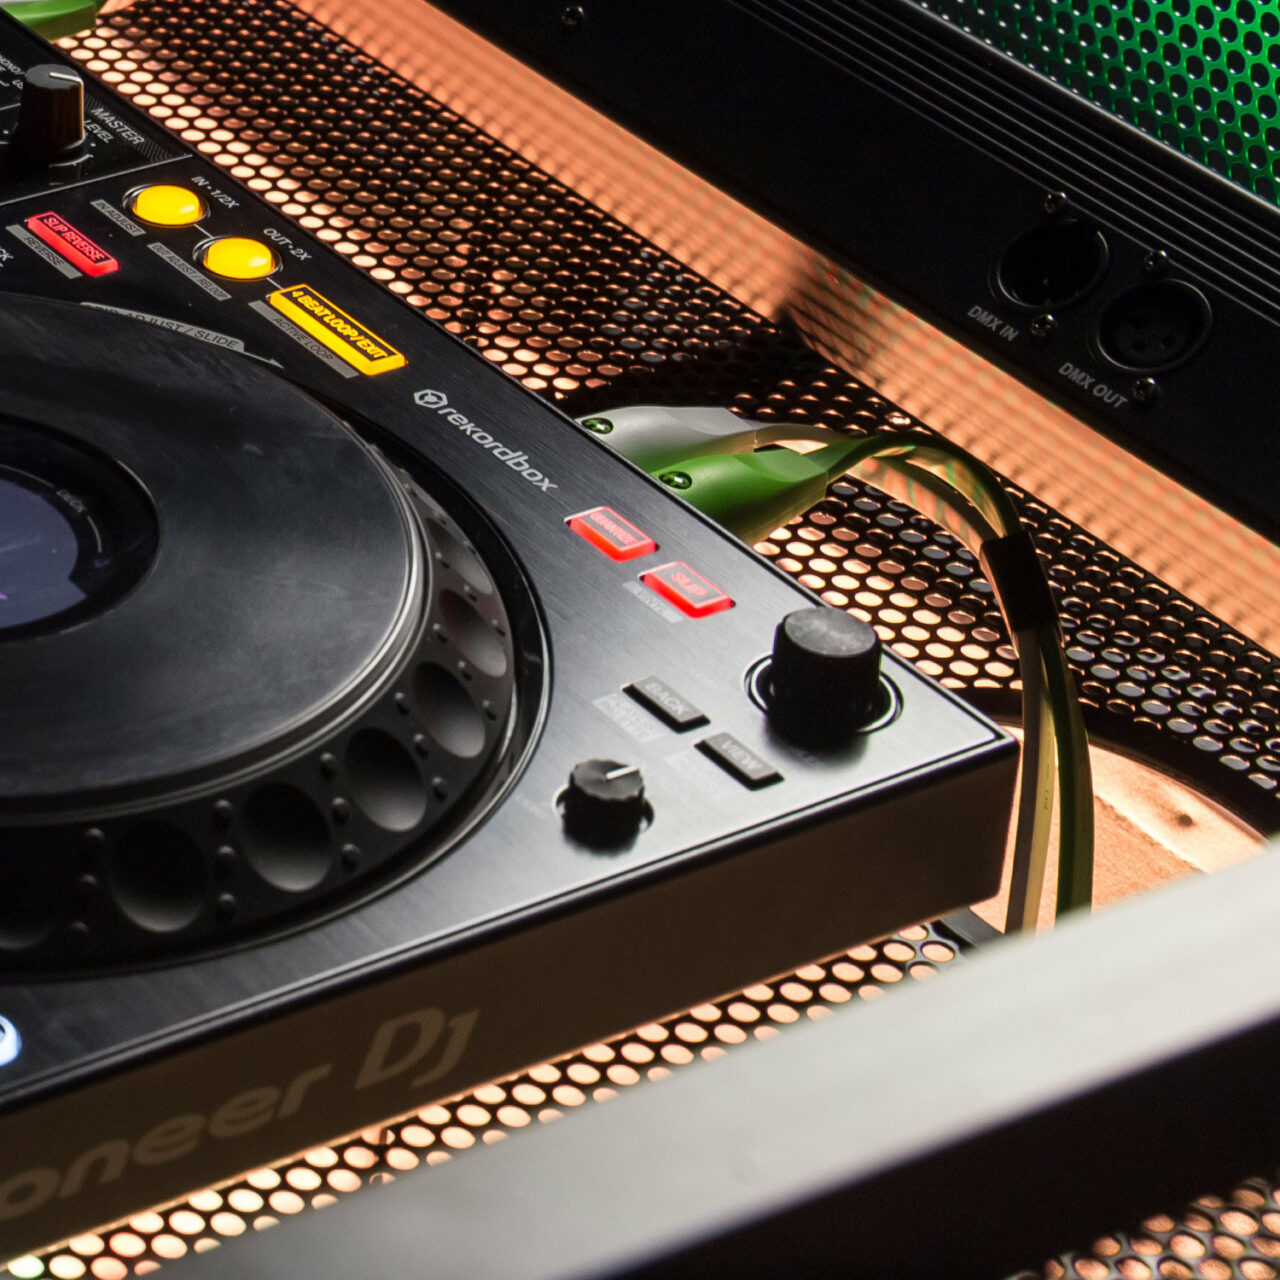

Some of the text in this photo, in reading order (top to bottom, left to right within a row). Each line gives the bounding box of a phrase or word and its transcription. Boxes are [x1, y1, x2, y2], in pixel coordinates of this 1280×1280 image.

[84, 120, 114, 143] LEVEL
[91, 108, 144, 145] MASTER
[25, 237, 65, 266] REVERSE
[65, 231, 106, 260] REVERSE
[194, 329, 236, 349] SLIDE
[967, 304, 1020, 342] DMX IN
[1058, 362, 1129, 408] DMX OUT
[437, 403, 559, 493] rekordbox
[590, 512, 641, 546] QUANTIZE
[671, 572, 707, 597] SLIP
[645, 683, 692, 716] BACK
[721, 739, 763, 772] VIEW
[354, 1007, 479, 1089] DJ
